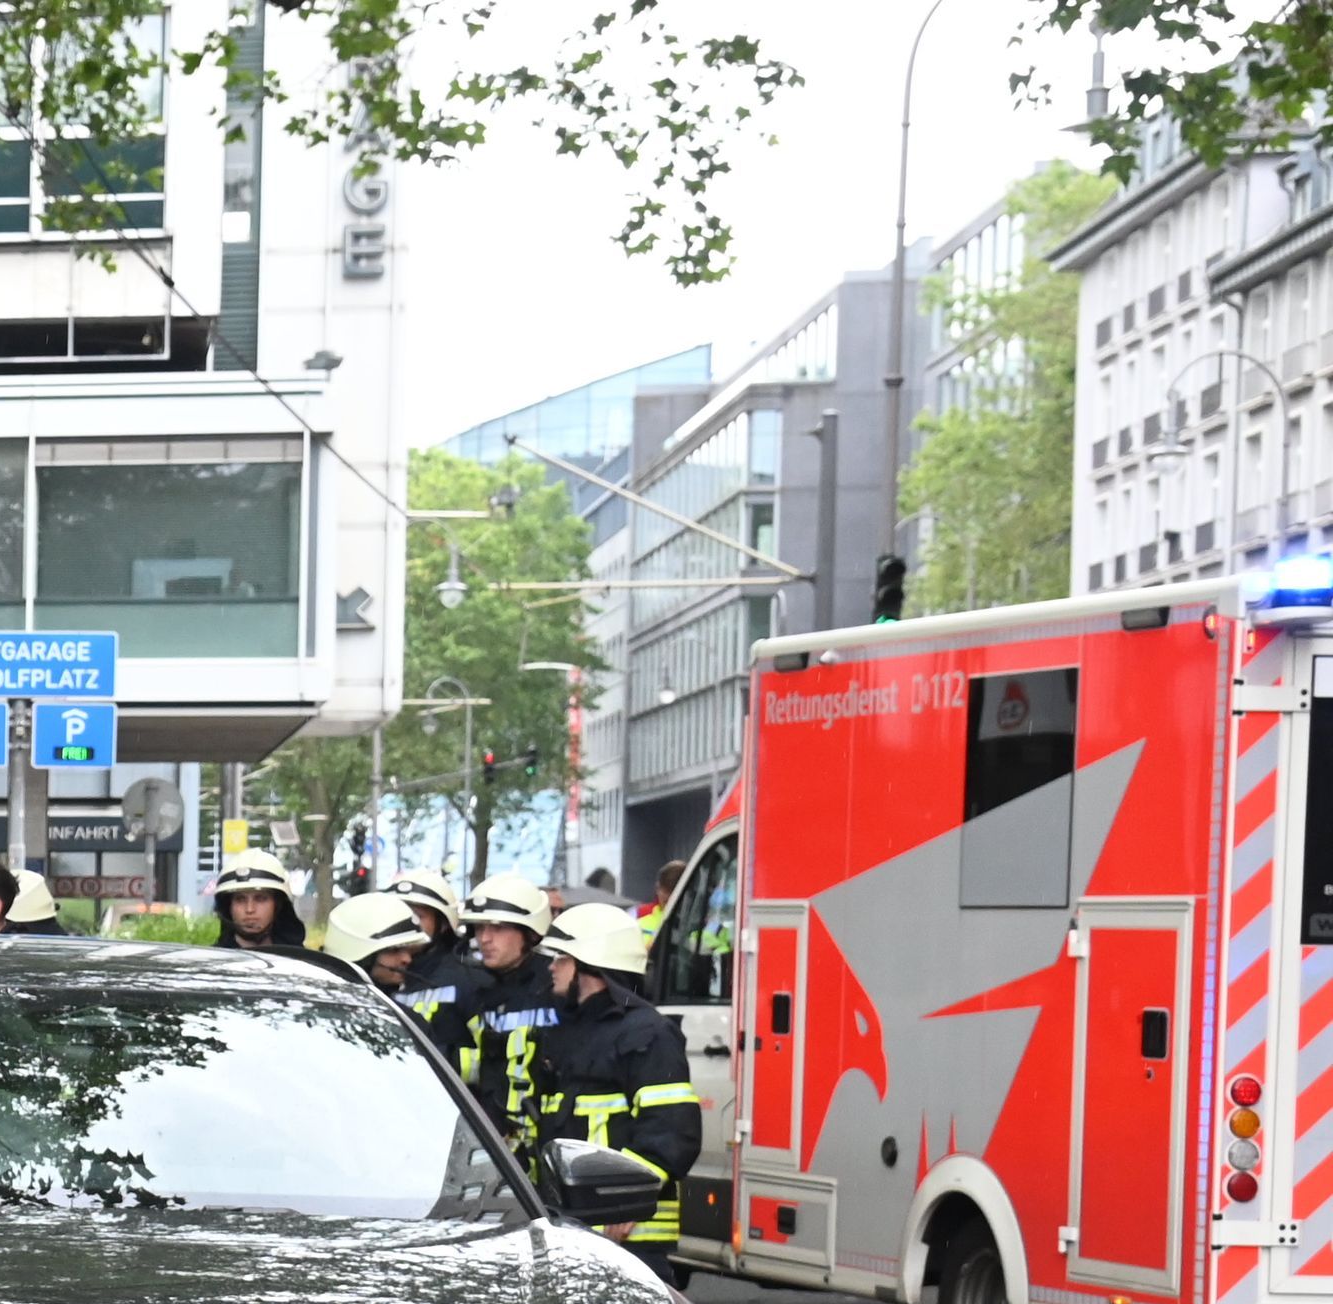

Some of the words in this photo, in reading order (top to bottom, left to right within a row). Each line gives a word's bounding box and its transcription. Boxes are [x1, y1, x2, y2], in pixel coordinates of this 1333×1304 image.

[765, 676, 900, 730] Rettungsdienst
[932, 671, 966, 709] 112
[48, 825, 119, 840] INFAHRT
